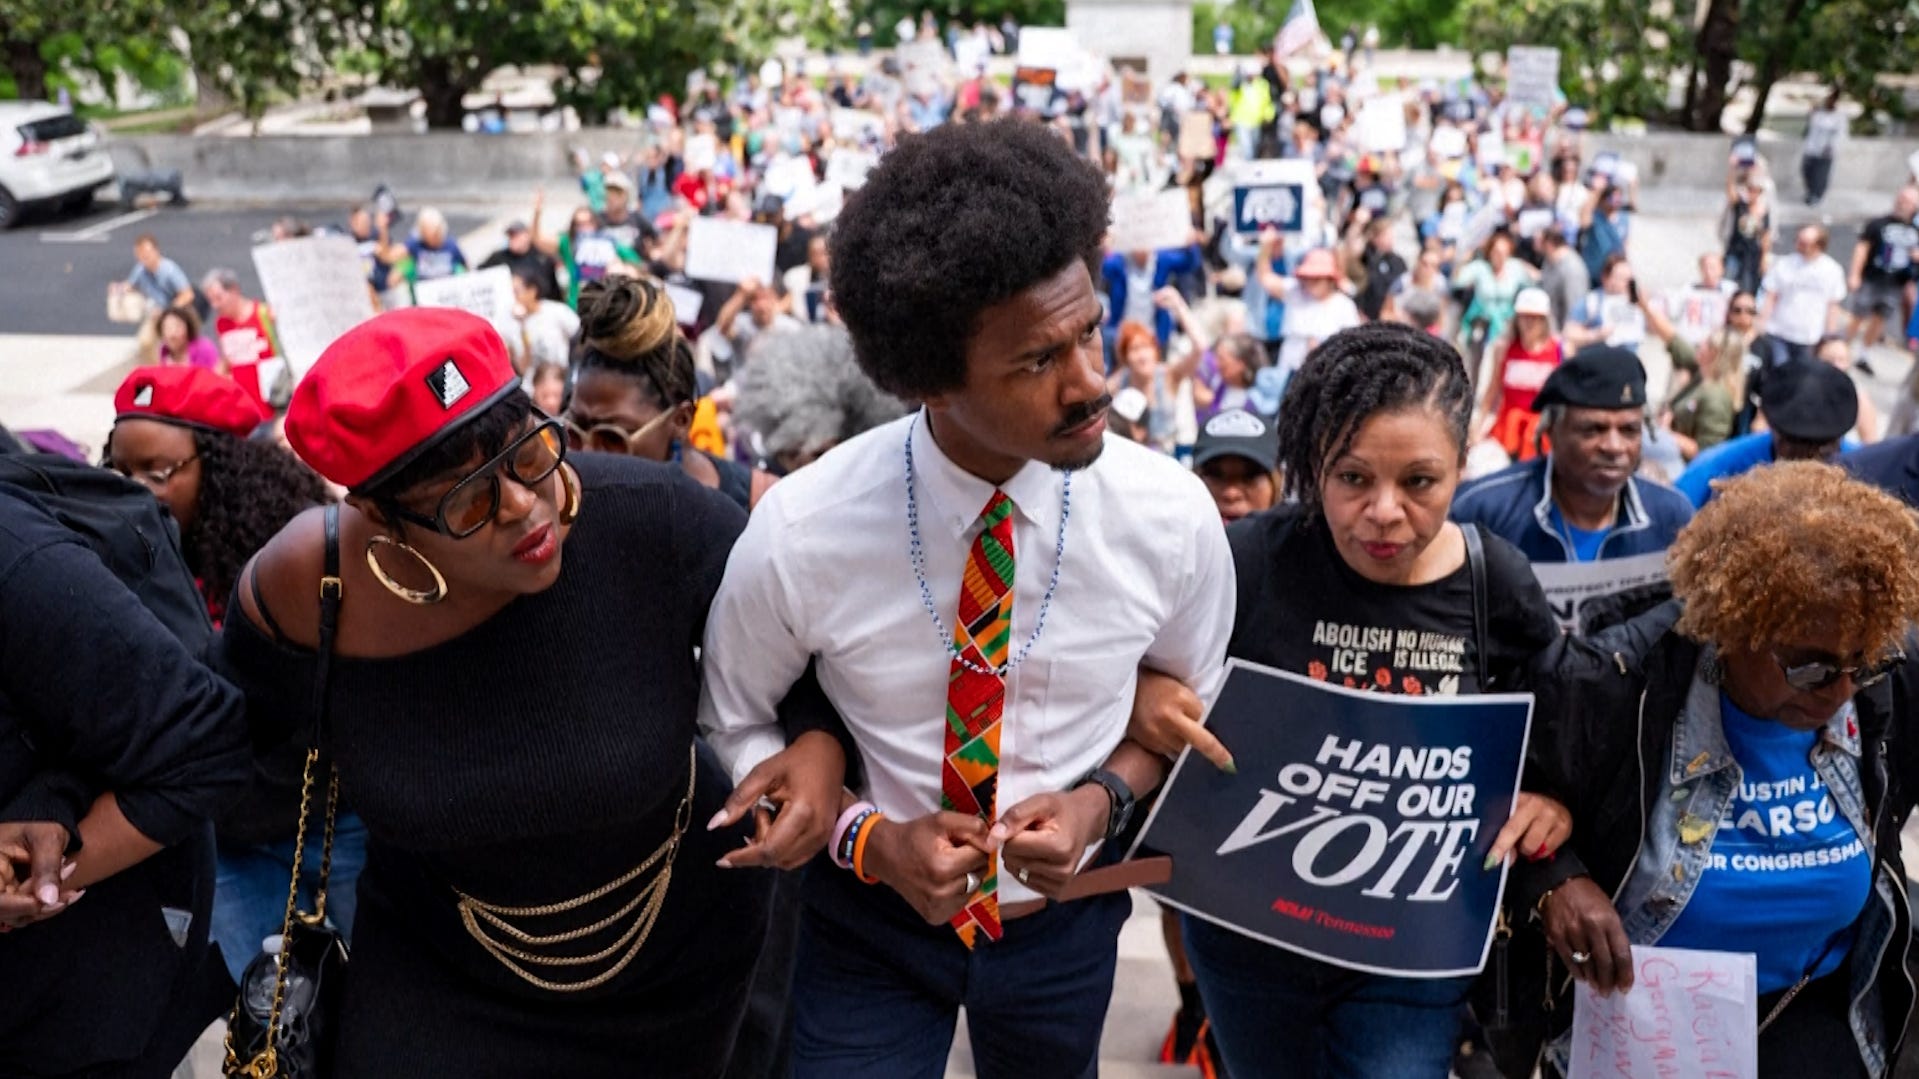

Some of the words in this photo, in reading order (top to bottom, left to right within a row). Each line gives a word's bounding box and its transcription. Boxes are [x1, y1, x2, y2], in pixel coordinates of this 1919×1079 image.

[1312, 620, 1393, 653] ABOLISH
[1396, 629, 1418, 651] NO
[1331, 648, 1369, 675] ICE
[1393, 649, 1409, 668] IS
[1315, 734, 1473, 780] HANDS
[1277, 762, 1391, 810] OFF
[1396, 783, 1476, 818] OUR
[1717, 793, 1837, 838] EARSO
[1215, 788, 1481, 902] VOTE
[1731, 837, 1865, 872] CONGRESSMA
